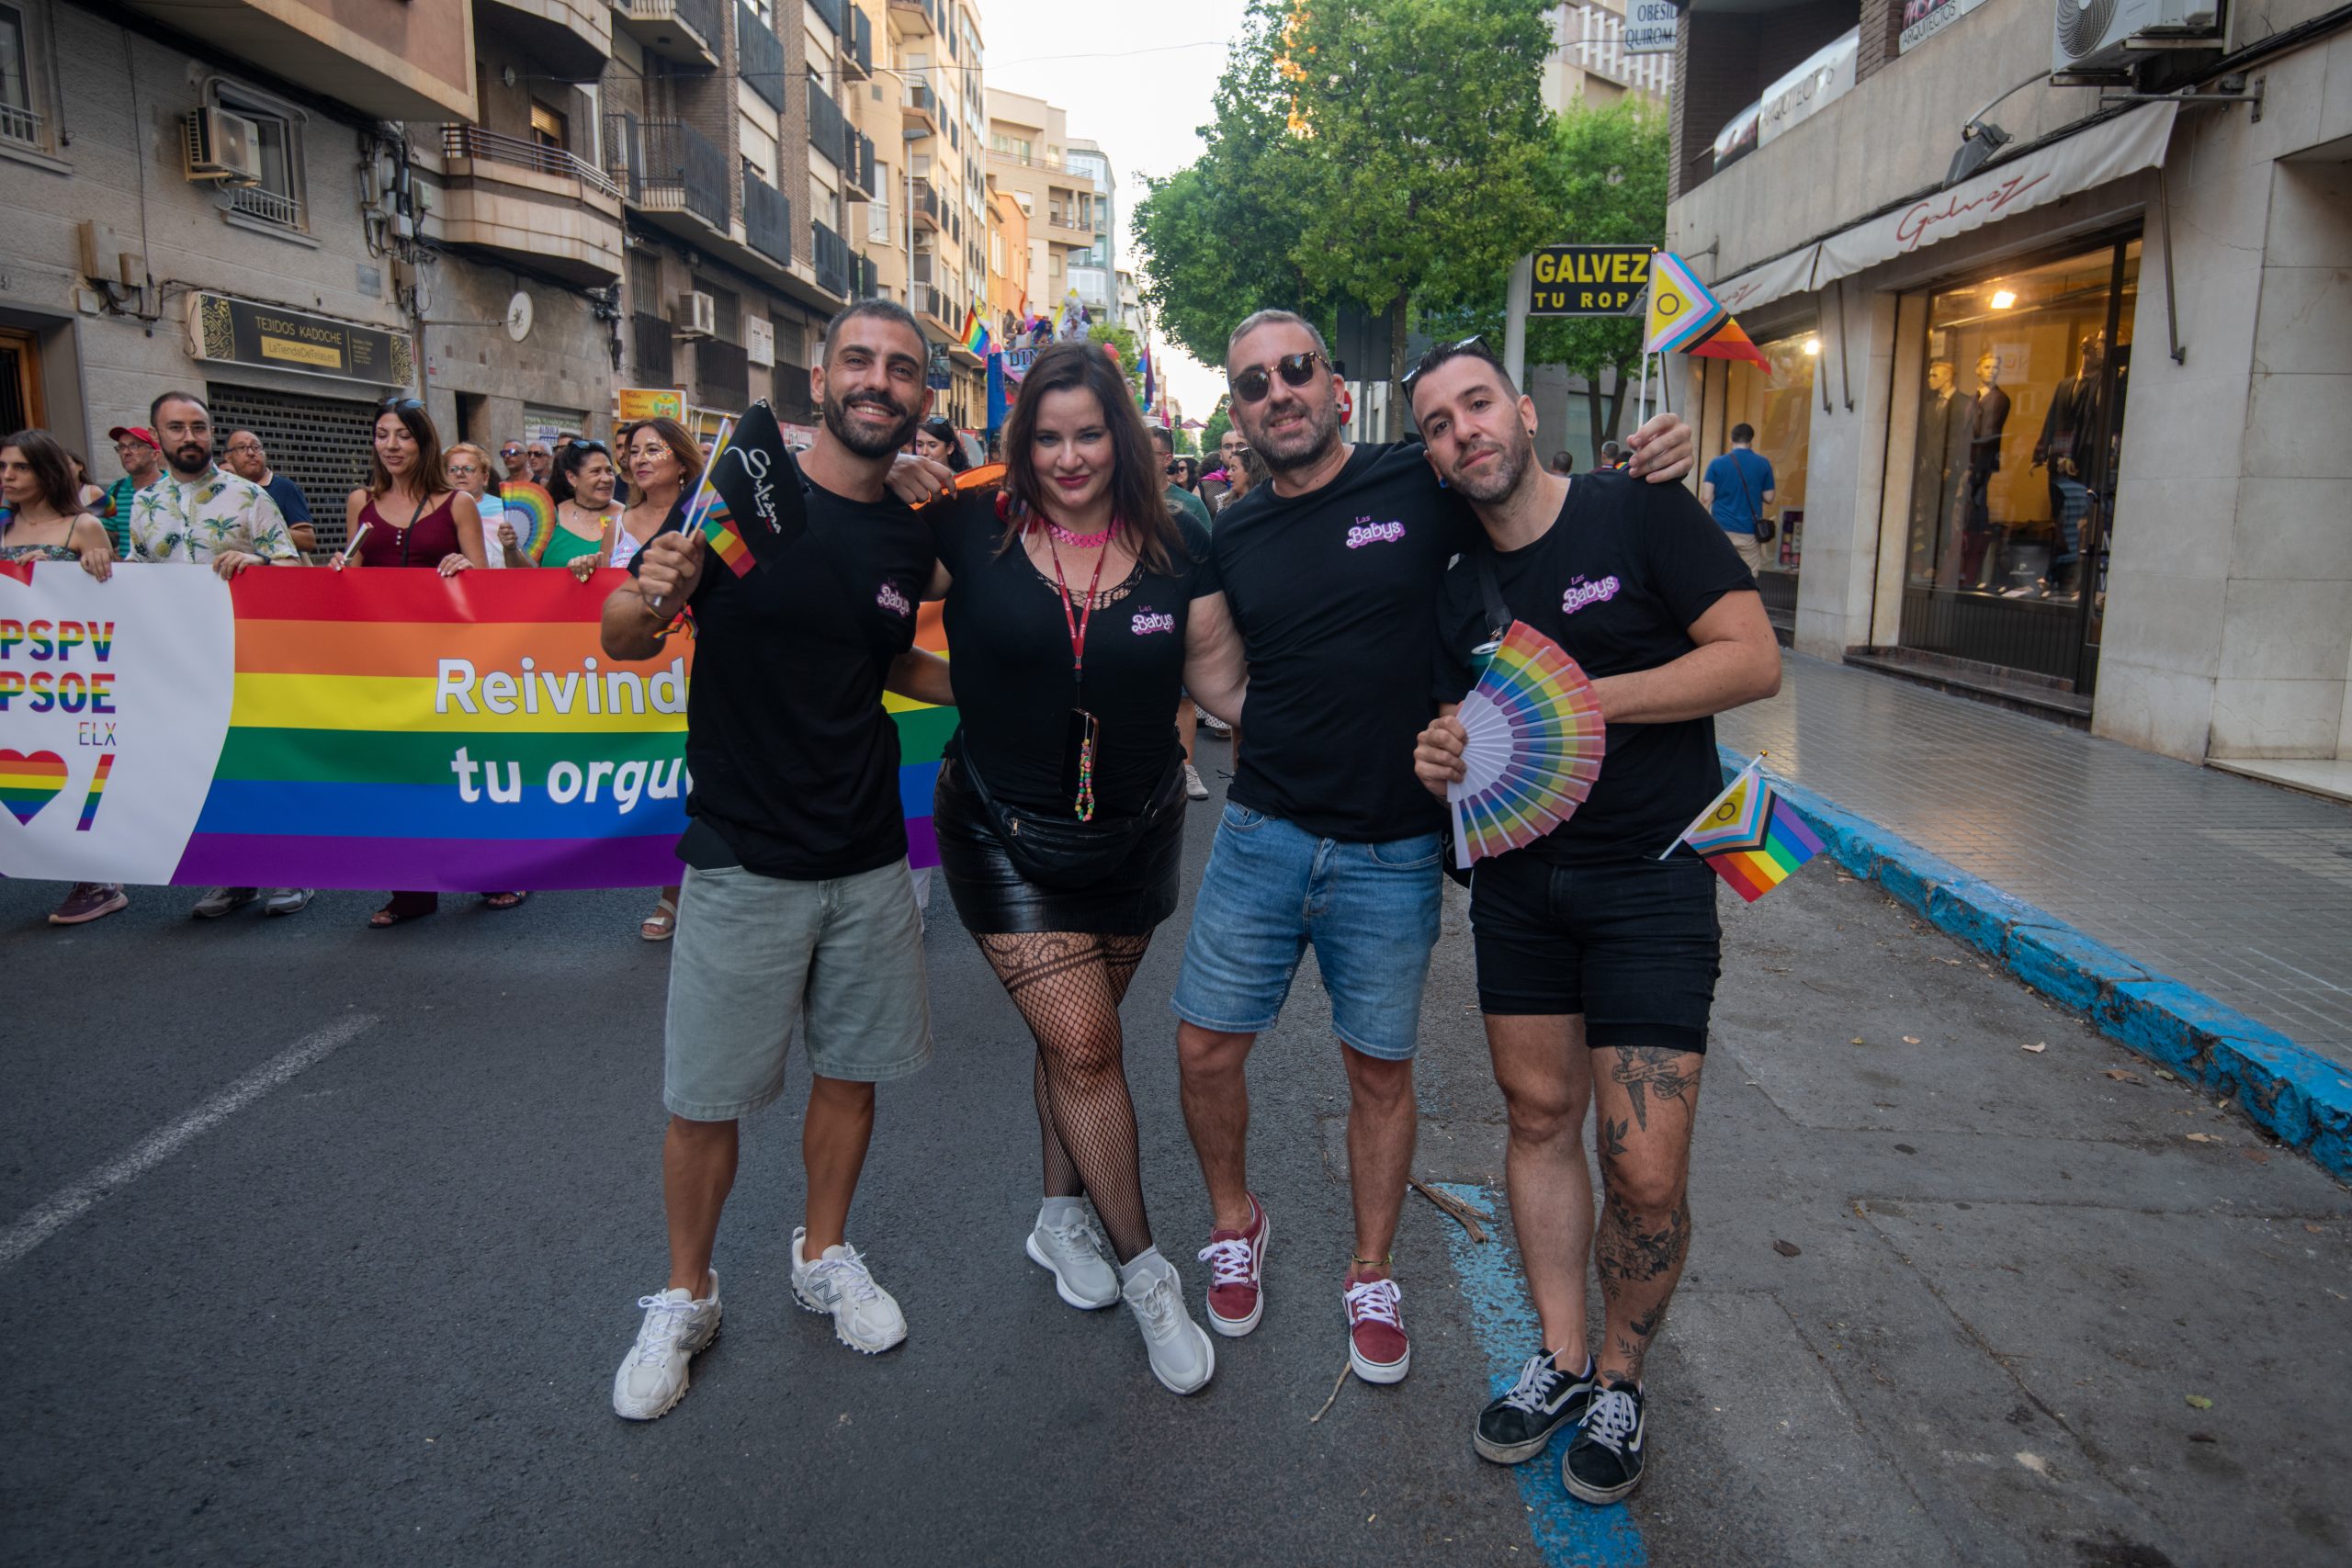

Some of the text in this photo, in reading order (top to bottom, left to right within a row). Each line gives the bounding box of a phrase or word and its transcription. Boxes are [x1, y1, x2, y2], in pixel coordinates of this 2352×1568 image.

[1625, 28, 1677, 51] QUIROM
[1534, 253, 1649, 283] GALVEZ
[1534, 291, 1639, 308] TU ROP
[254, 316, 343, 345] TEJIDOS KADOCHE
[1346, 521, 1404, 548] Babys
[1356, 515, 1371, 525] Las
[1562, 575, 1619, 614] Babys
[1570, 574, 1586, 586] Las
[877, 585, 910, 616] Babys
[1131, 613, 1174, 634] Babys
[0, 619, 115, 662] PSPV
[0, 671, 117, 714] PSOE
[435, 657, 687, 715] Reivind
[78, 721, 117, 746] ELX
[449, 746, 695, 815] tu orgu
